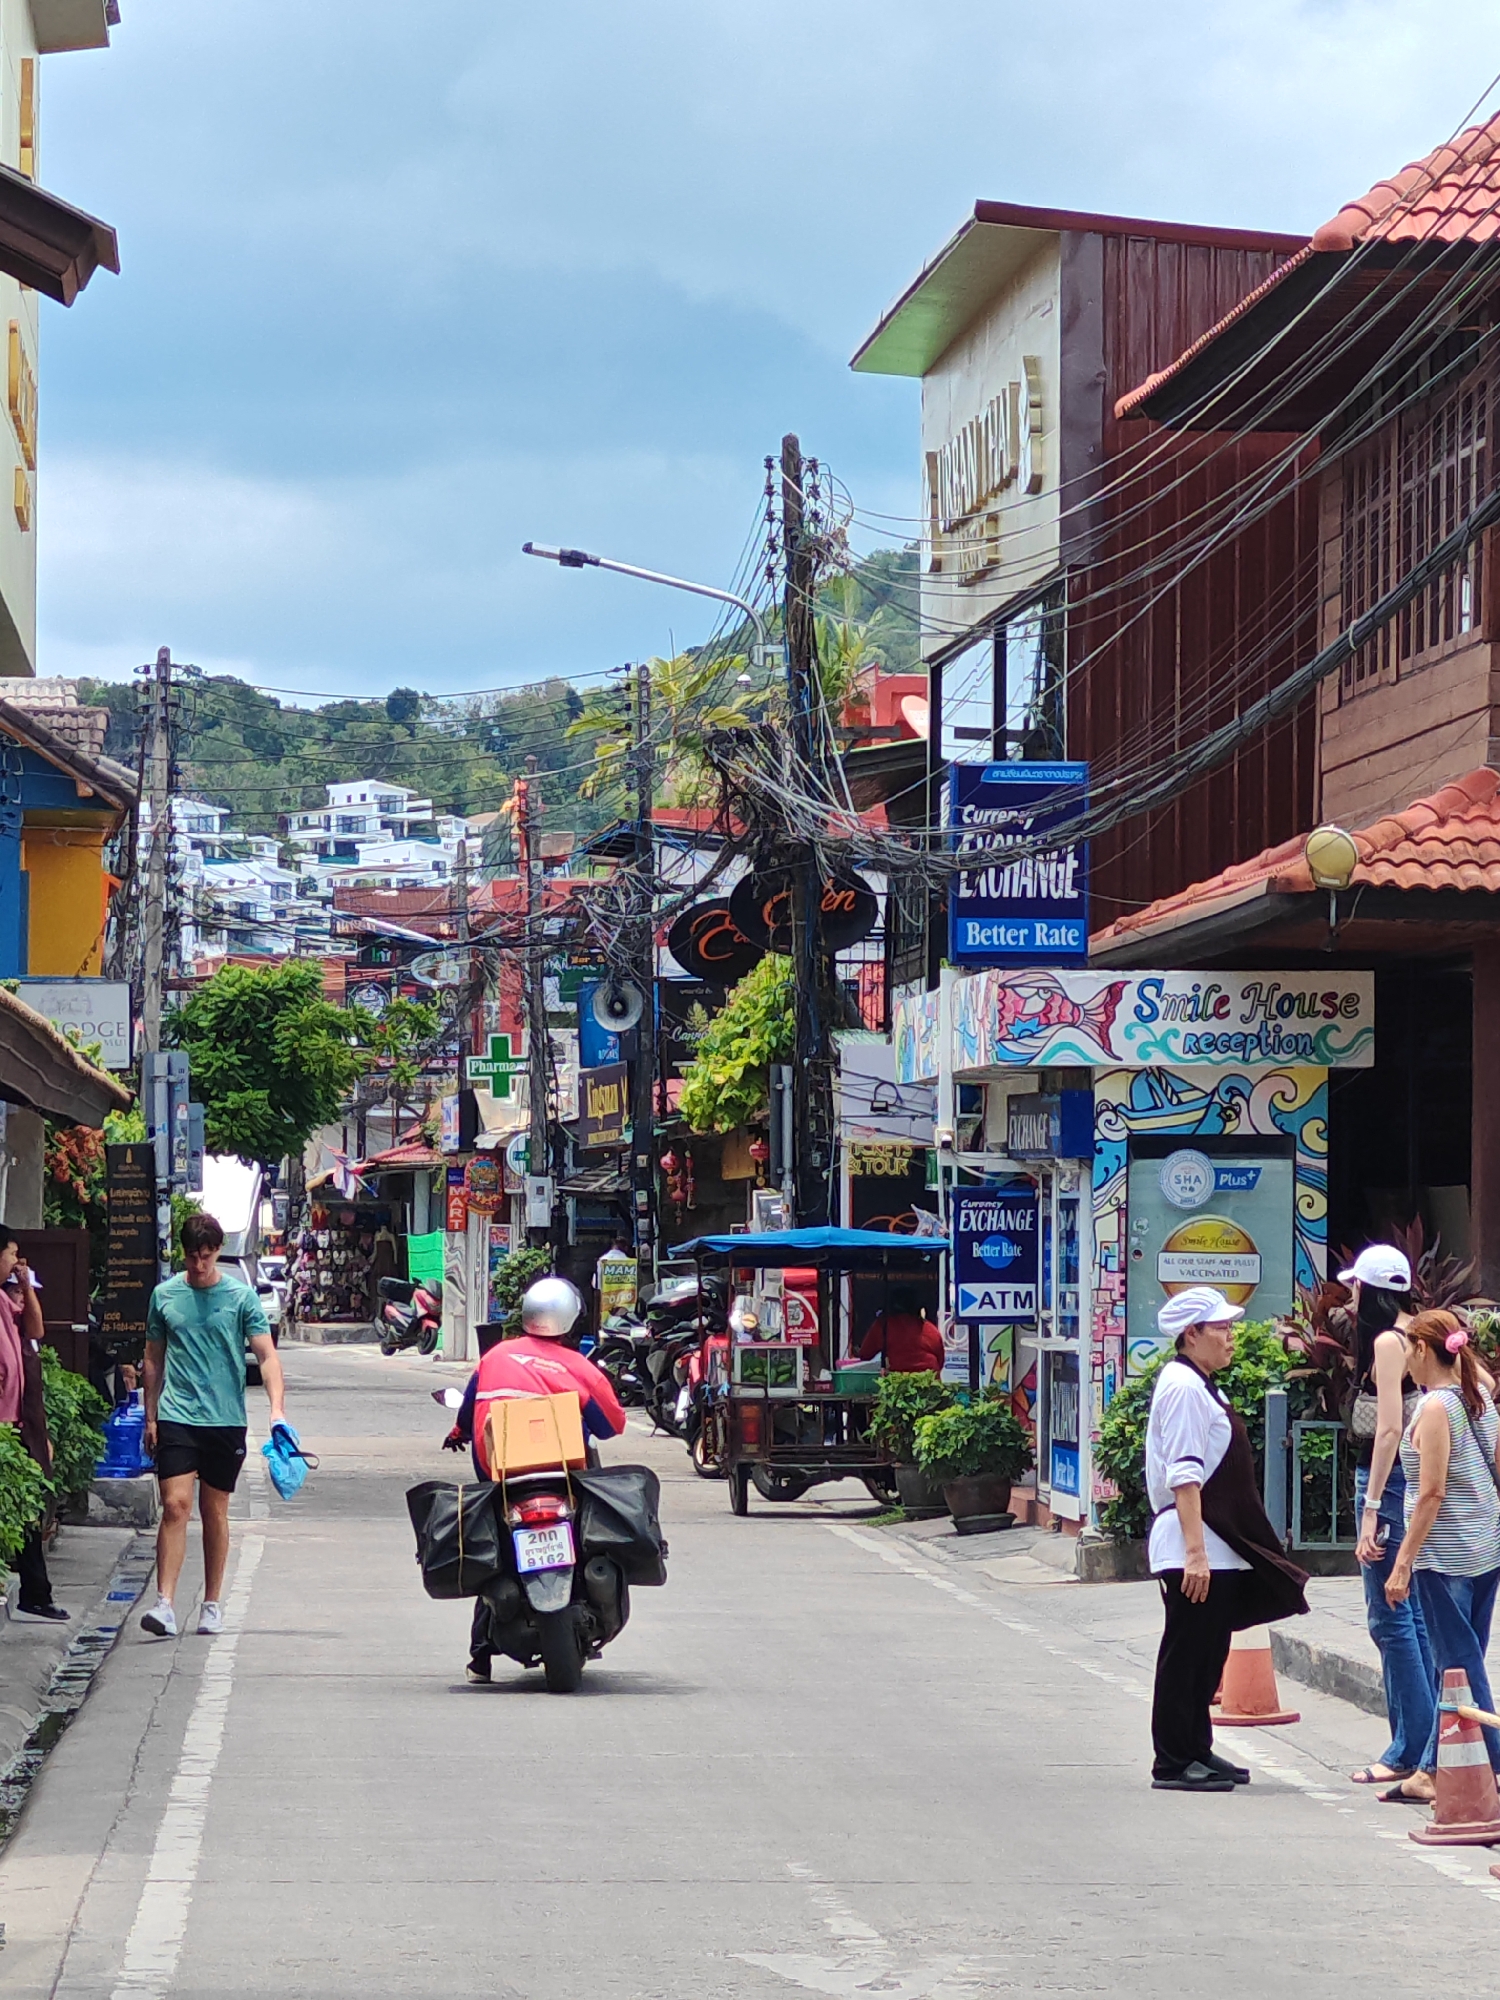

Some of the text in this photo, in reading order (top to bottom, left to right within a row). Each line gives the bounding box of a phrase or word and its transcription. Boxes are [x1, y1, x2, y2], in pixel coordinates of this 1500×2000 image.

[966, 921, 1080, 946] Better Rate
[1133, 977, 1361, 1024] Smile House
[56, 1021, 127, 1038] ODGE
[470, 1060, 528, 1074] Pharma
[1008, 1112, 1049, 1150] EXCHANGE
[864, 1157, 910, 1176] TOUR
[1174, 1174, 1202, 1185] SHA
[449, 1186, 466, 1230] MART
[959, 1209, 1034, 1232] EXCHANGE
[972, 1241, 1023, 1258] Better Rate
[1163, 1257, 1175, 1265] ALL
[1180, 1269, 1239, 1278] VACCINATED
[977, 1290, 1034, 1311] ATM
